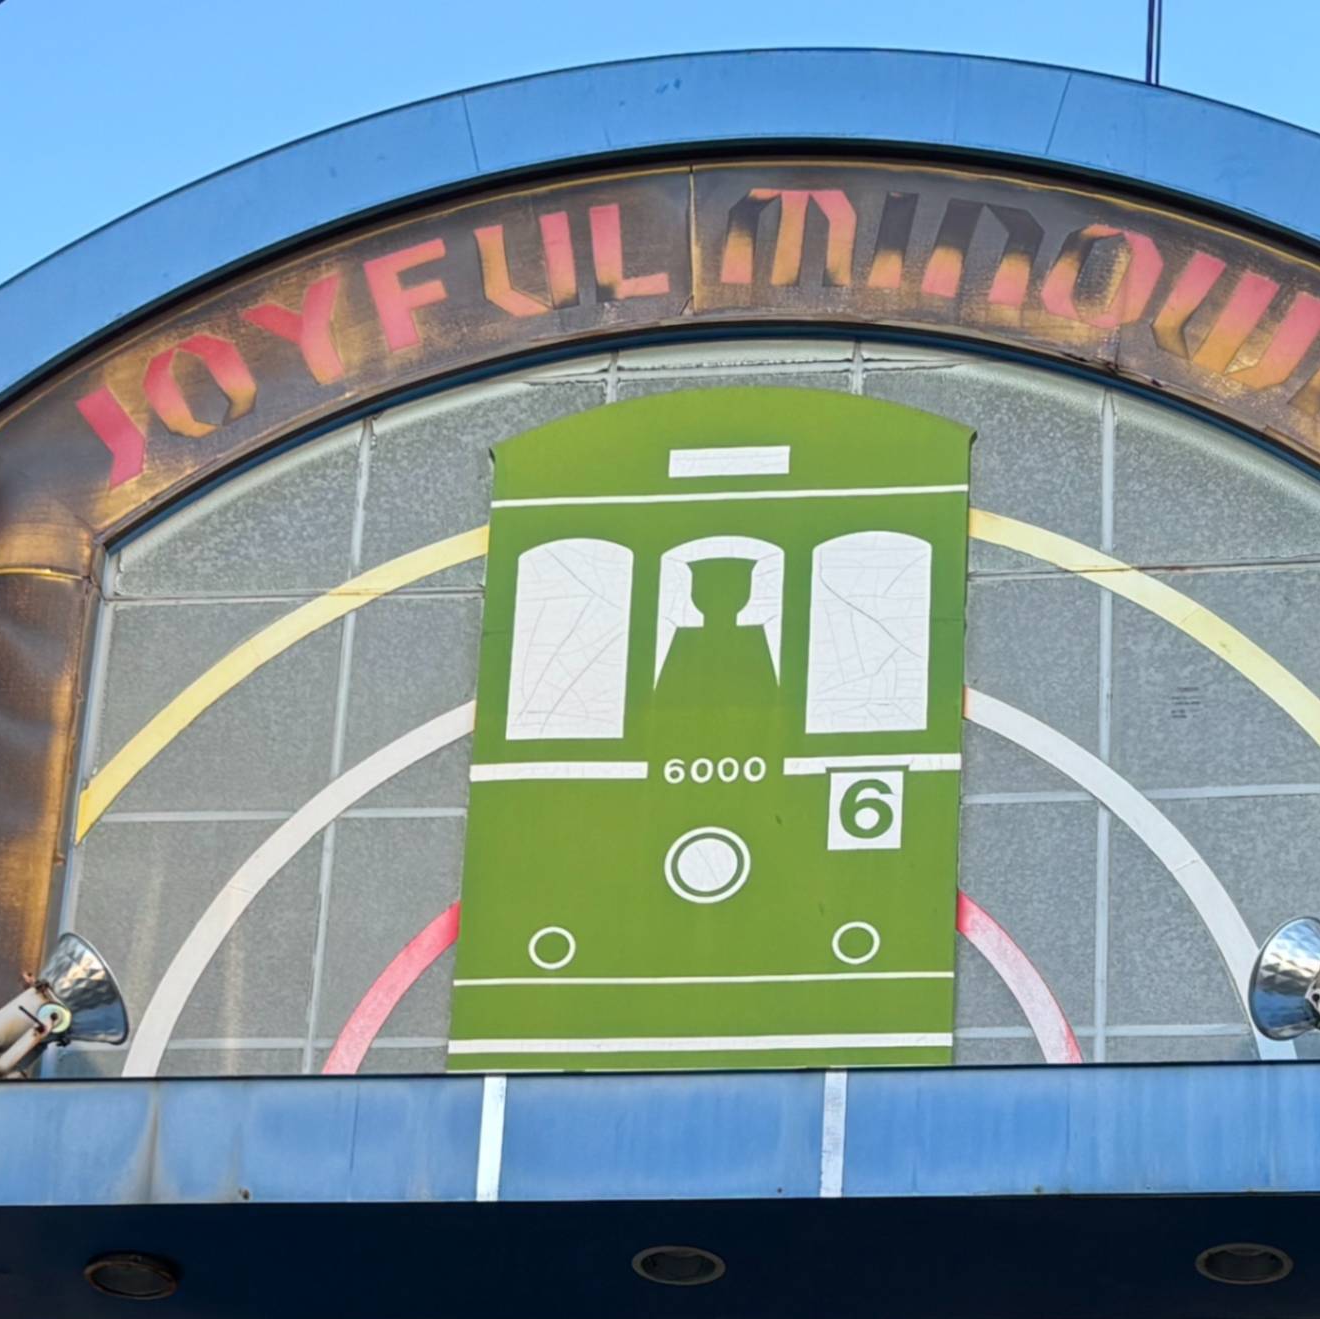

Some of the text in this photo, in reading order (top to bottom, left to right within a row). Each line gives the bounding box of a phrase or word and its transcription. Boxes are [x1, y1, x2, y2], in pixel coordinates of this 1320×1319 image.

[75, 203, 671, 489] JOYFUL
[663, 756, 767, 784] 6000
[838, 778, 895, 839] 6
